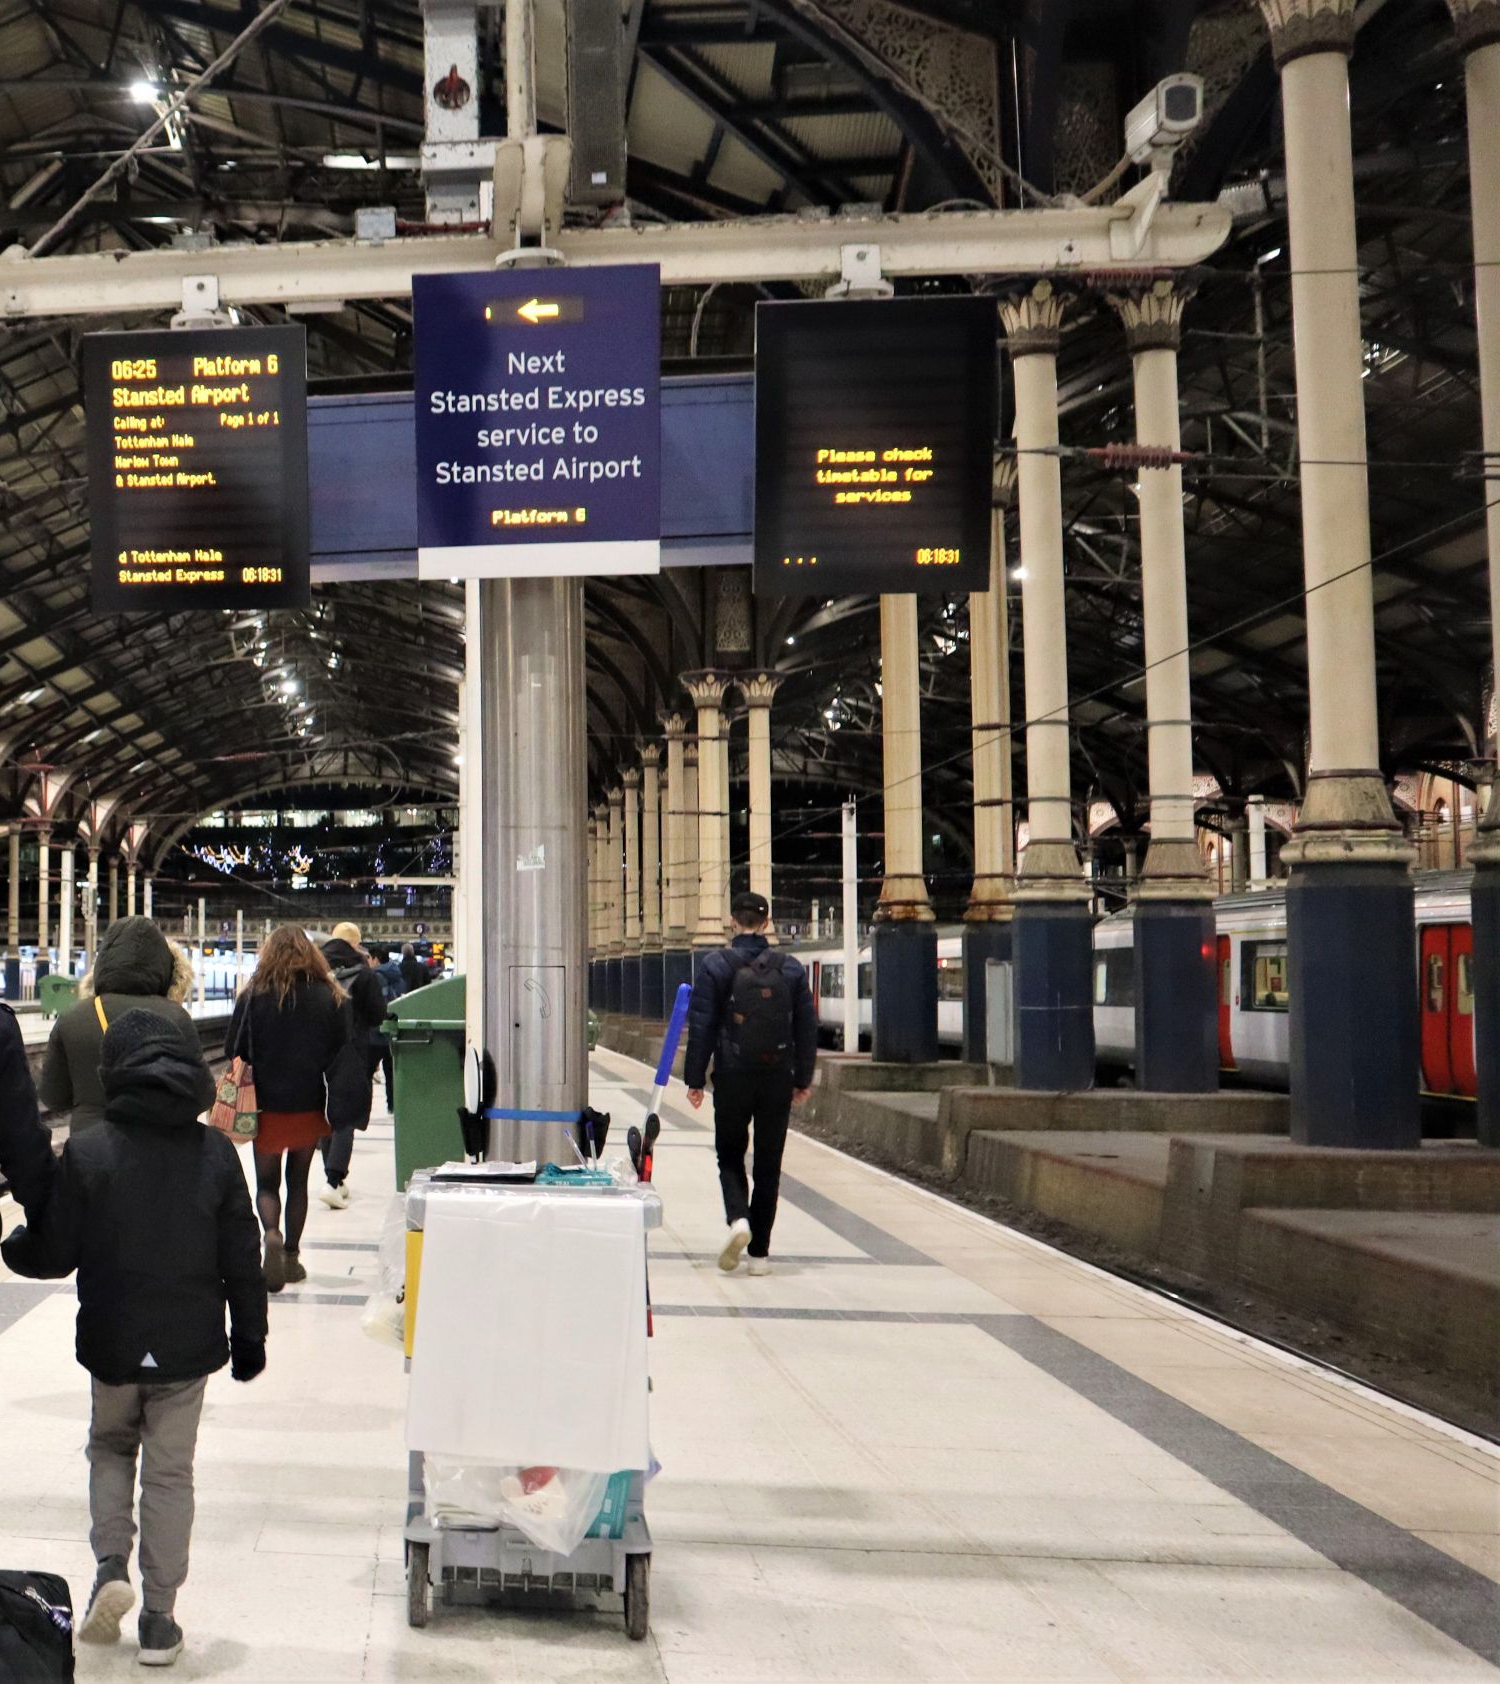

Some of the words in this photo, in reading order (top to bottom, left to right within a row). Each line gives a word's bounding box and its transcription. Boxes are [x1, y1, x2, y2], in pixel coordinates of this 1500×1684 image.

[112, 360, 156, 380] 06:25
[194, 356, 261, 377] Platform
[267, 355, 278, 374] 6
[509, 350, 565, 374] Next
[113, 386, 185, 407] Stansted
[190, 383, 249, 406] Airport
[431, 387, 538, 413] Stansted
[549, 387, 645, 412] Express
[114, 416, 147, 432] Calling
[220, 413, 244, 429] Page
[248, 412, 254, 425] 1
[256, 412, 269, 425] of
[273, 411, 279, 425] 1
[115, 435, 169, 449] Tottenham
[172, 434, 194, 448] Hale
[478, 423, 565, 447] service
[573, 422, 598, 443] to
[115, 455, 149, 469] Harlow
[152, 454, 178, 467] Town
[817, 450, 875, 463] Please
[882, 447, 932, 462] check
[437, 459, 543, 483] Stansted
[553, 455, 641, 483] Airport
[816, 468, 897, 483] timetable
[904, 468, 933, 481] for
[127, 473, 173, 487] Stansted
[835, 489, 911, 503] services
[492, 510, 568, 525] Platform
[574, 508, 585, 522] 6
[131, 550, 191, 563] Tottenham
[195, 549, 222, 562] Hale
[119, 569, 172, 583] Stansted
[176, 569, 224, 583] Express
